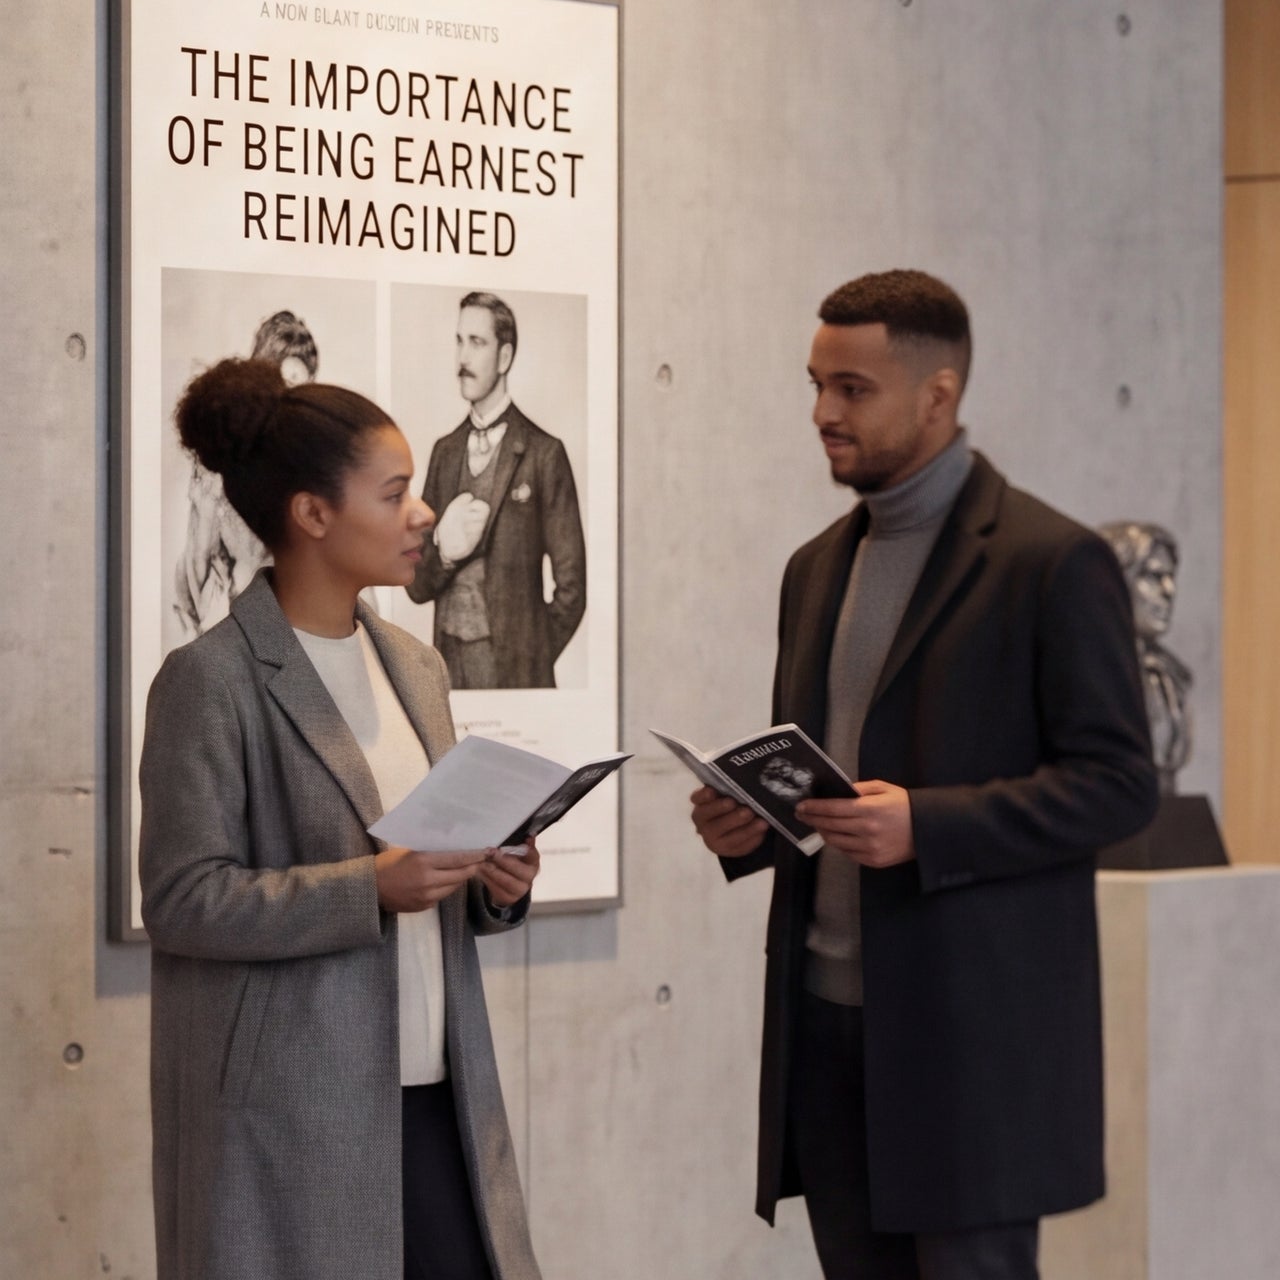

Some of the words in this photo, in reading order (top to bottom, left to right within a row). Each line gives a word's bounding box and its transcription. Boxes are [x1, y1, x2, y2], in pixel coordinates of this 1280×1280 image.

[260, 1, 271, 18] A
[181, 46, 270, 104] THE
[290, 58, 572, 134] IMPORTANCE
[168, 115, 224, 167] OF
[244, 122, 374, 181] BEING
[394, 135, 584, 199] EARNEST
[244, 190, 516, 258] REIMAGINED
